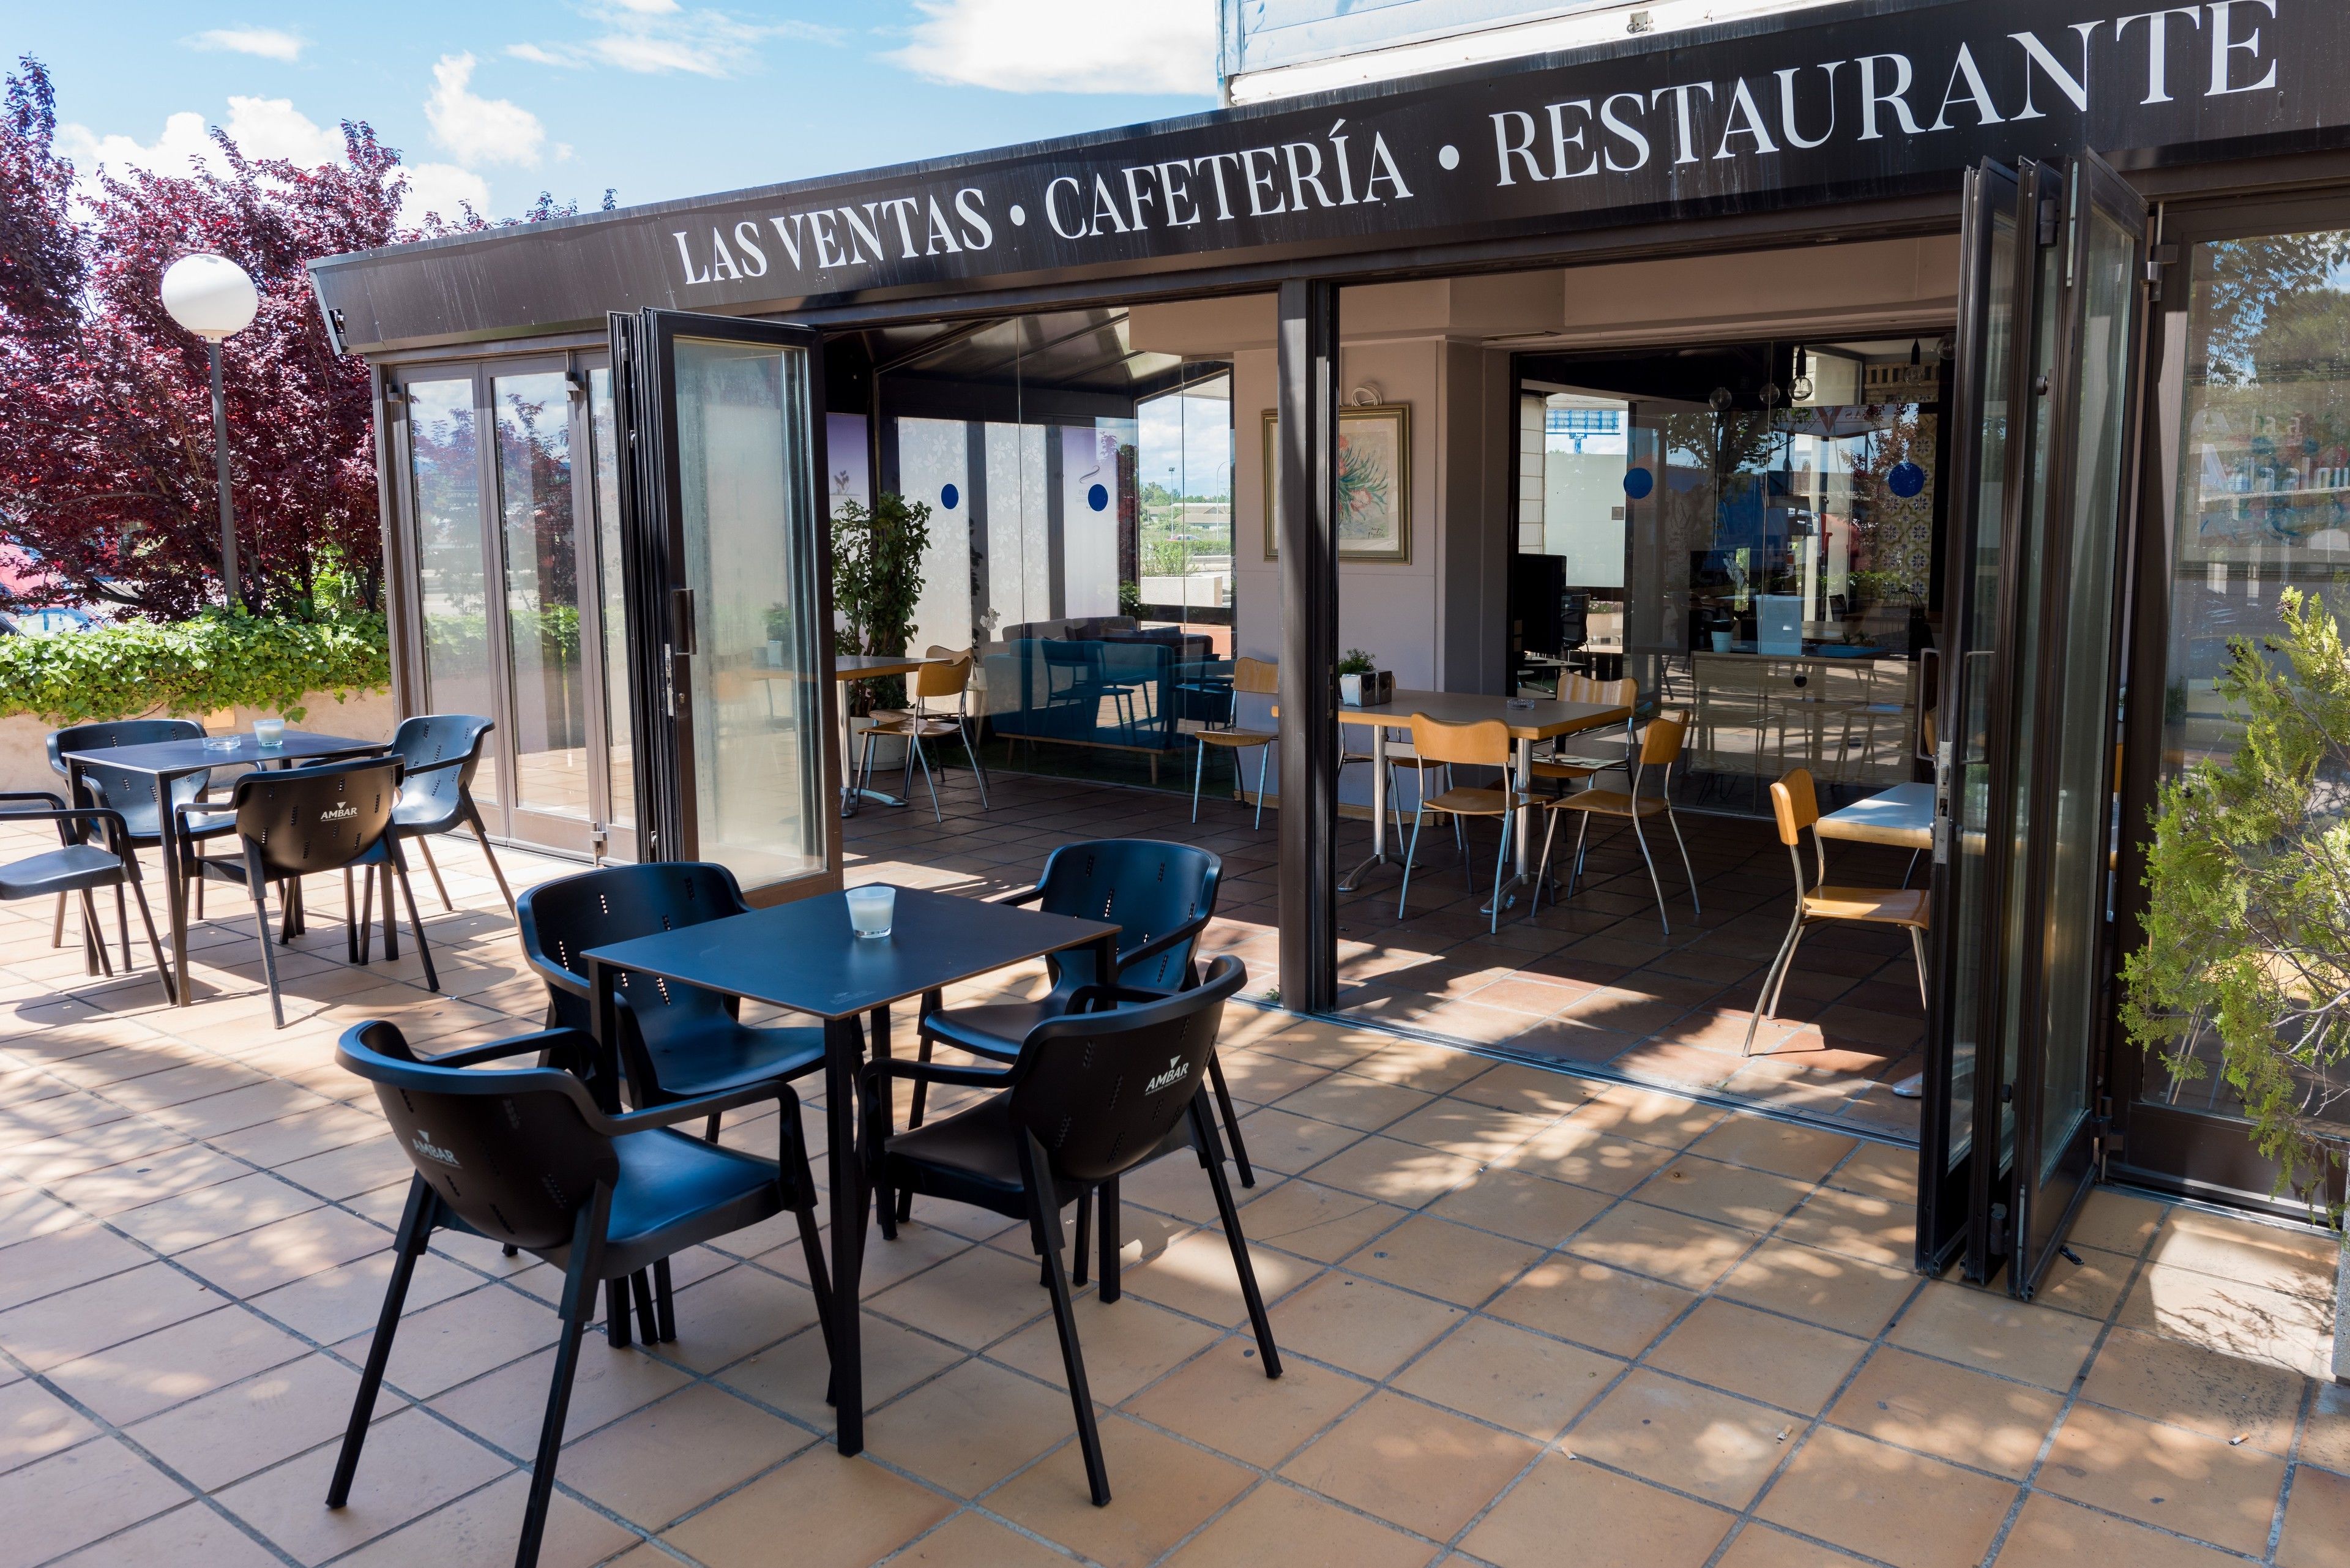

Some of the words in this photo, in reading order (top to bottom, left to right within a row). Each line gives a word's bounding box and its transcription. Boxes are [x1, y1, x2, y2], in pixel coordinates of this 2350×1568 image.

[673, 222, 767, 285] LAS
[769, 188, 993, 271] VENTAS
[1045, 118, 1414, 239] CAFETERÍA
[1488, 0, 2277, 186] RESTAURANTE
[321, 807, 357, 819] AMBAR
[1146, 1062, 1189, 1092] AMBAR
[412, 1138, 460, 1165] AMBAR
